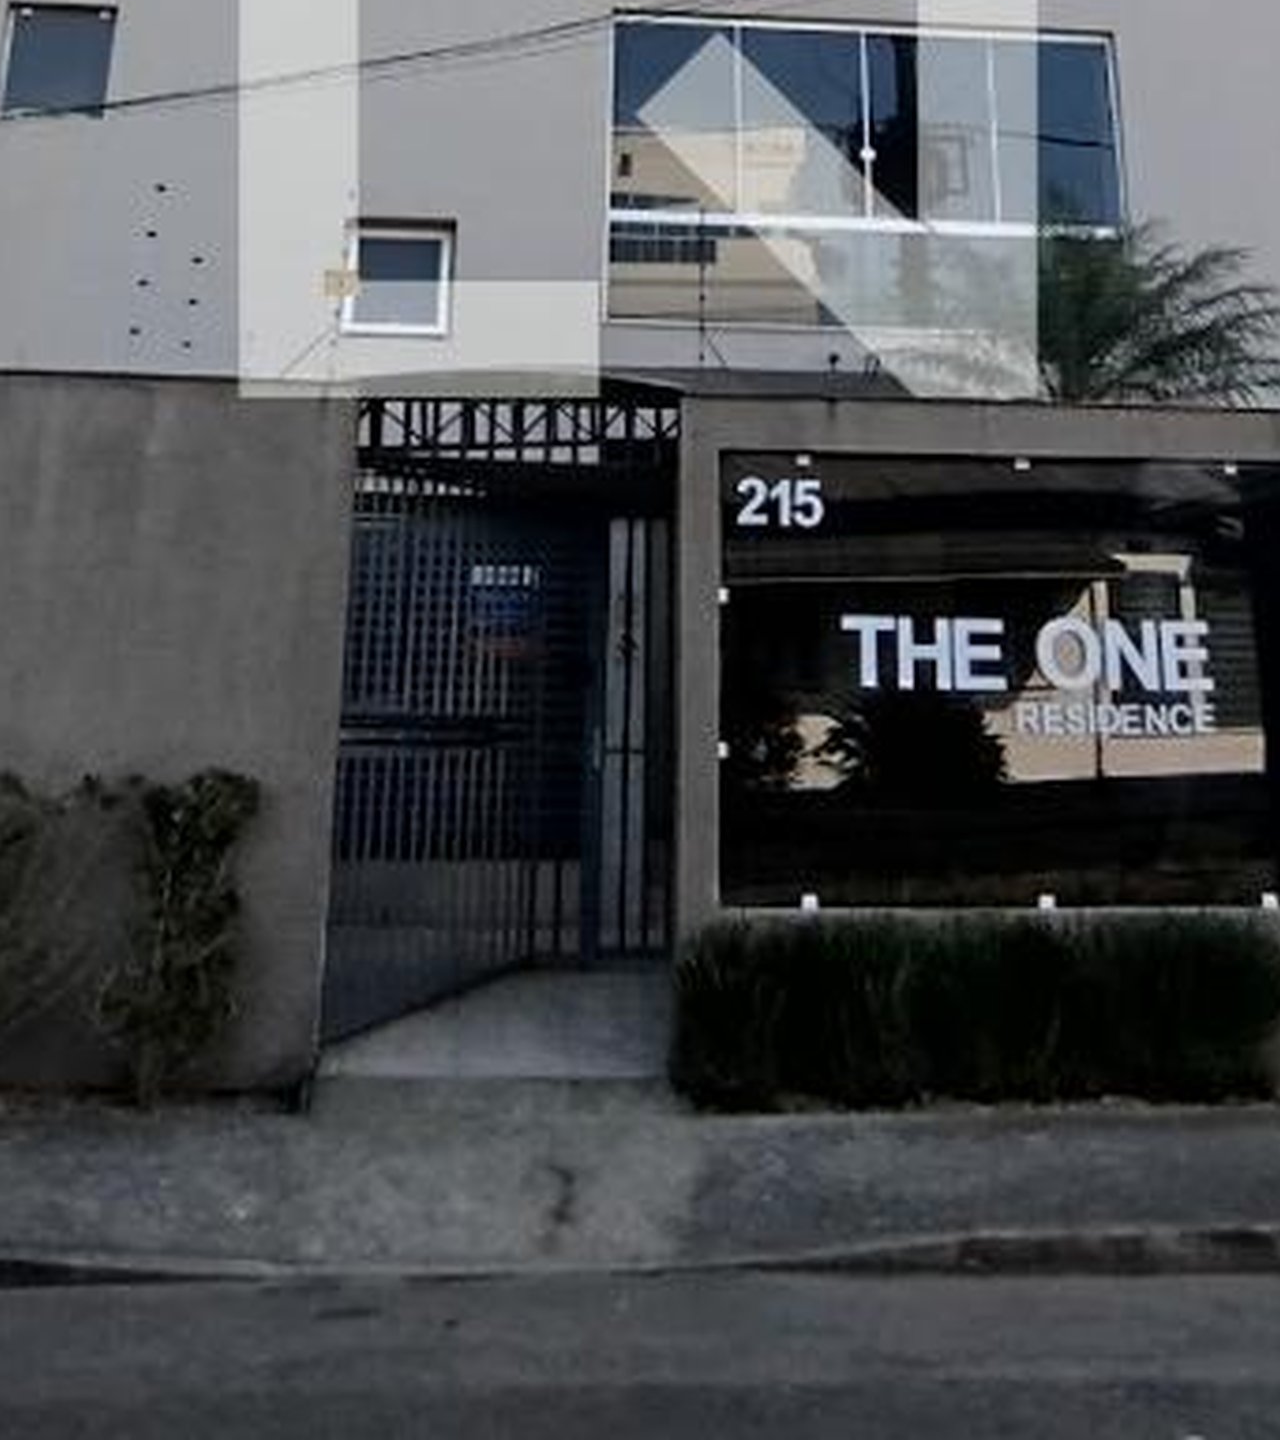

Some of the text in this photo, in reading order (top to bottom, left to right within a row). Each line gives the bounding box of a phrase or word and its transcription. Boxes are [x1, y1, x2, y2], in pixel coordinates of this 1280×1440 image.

[737, 476, 824, 527] 215
[840, 614, 1214, 691] THE ONE
[1018, 702, 1216, 735] RESIDENCE
